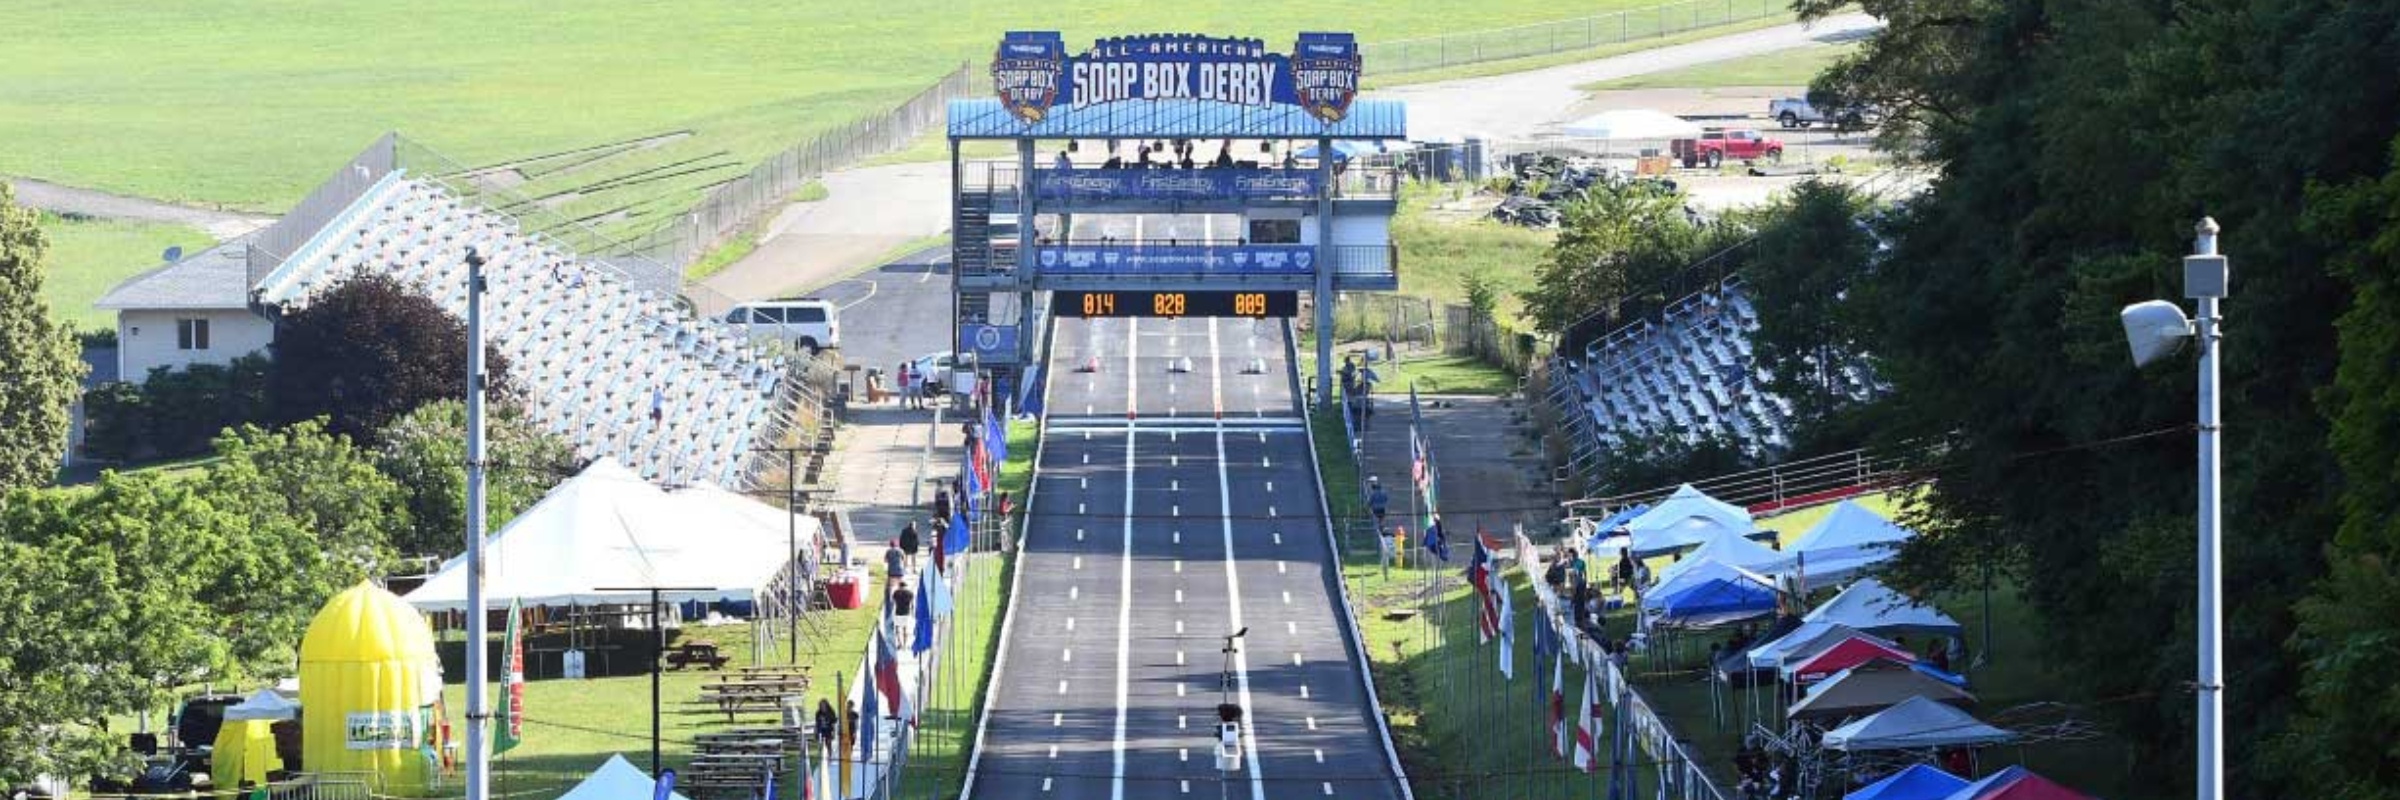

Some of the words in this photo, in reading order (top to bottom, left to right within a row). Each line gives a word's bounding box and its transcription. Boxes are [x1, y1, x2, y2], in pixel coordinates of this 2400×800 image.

[1090, 41, 1264, 60] ALL-AMERICAN
[999, 70, 1030, 91] SOAP
[1030, 70, 1056, 91] BOX
[1072, 62, 1138, 112] SOAP
[1143, 61, 1191, 100] BOX
[1201, 61, 1277, 110] DERBY
[1296, 70, 1328, 91] SOAP
[1329, 70, 1355, 91] BOX
[1010, 87, 1044, 101] DERBY
[1309, 87, 1342, 101] DERBY
[1083, 293, 1115, 315] 014
